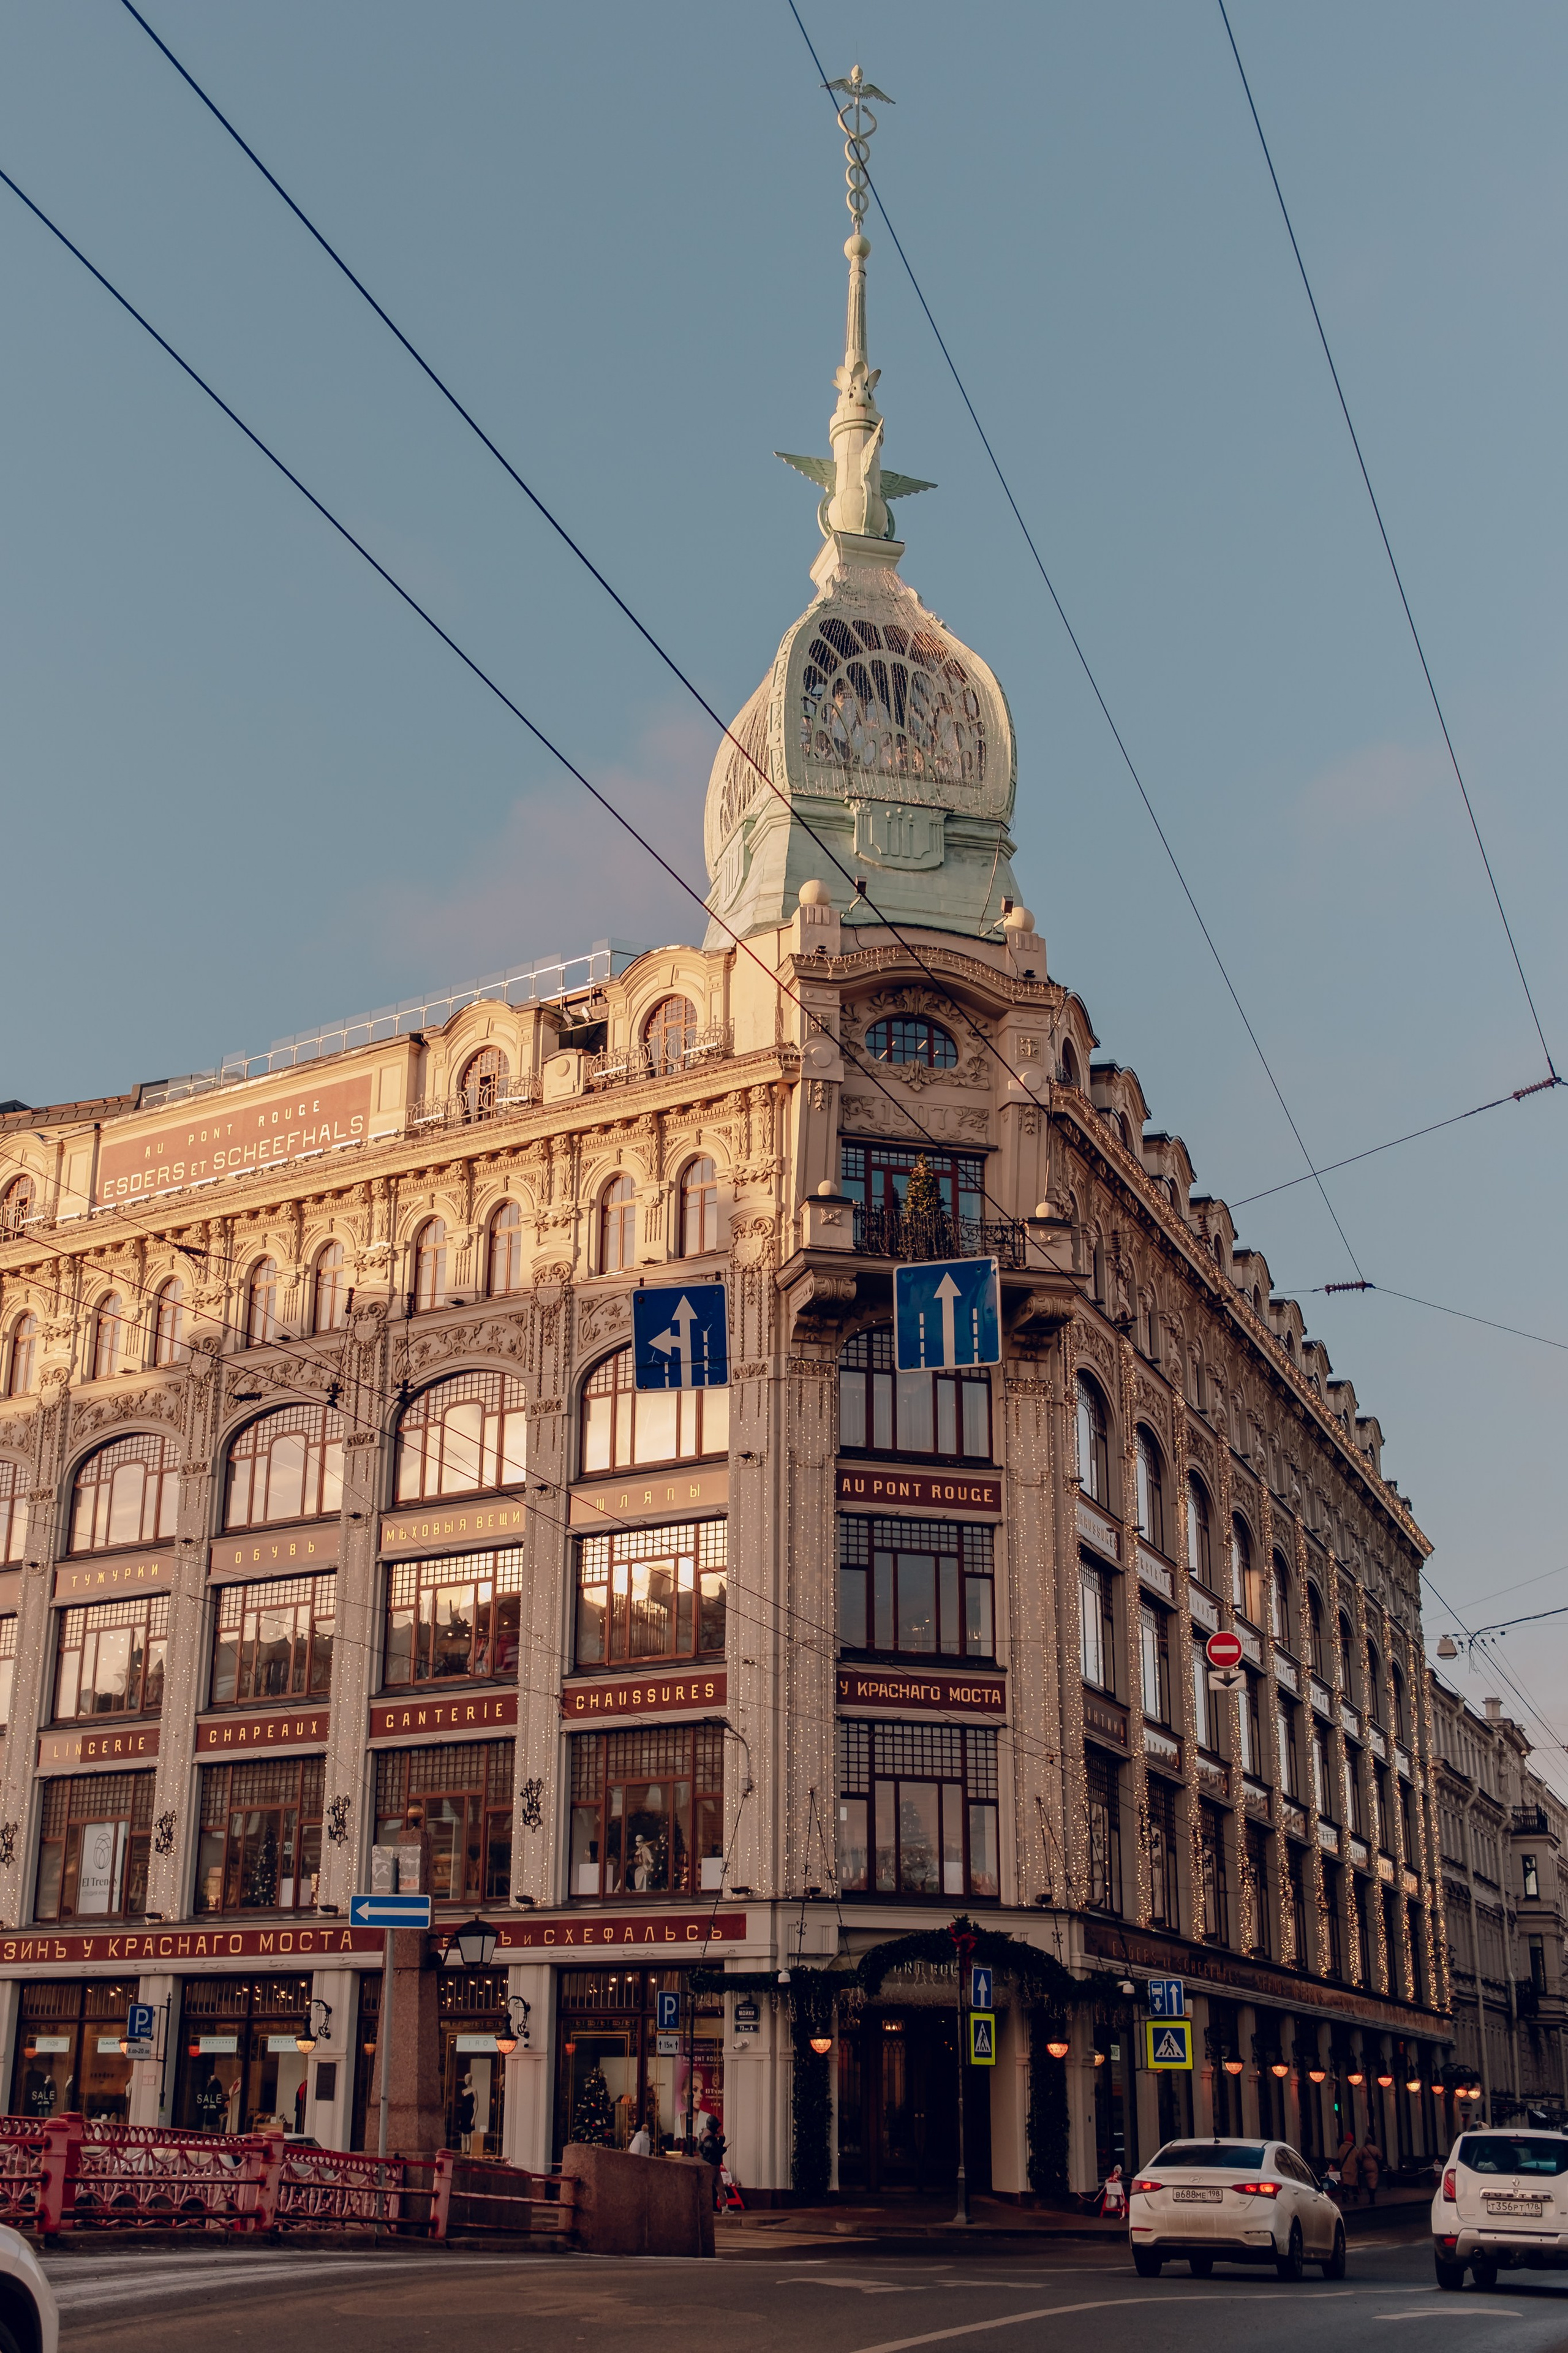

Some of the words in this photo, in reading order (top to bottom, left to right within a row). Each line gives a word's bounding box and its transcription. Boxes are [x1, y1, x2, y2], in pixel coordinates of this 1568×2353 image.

[144, 1141, 165, 1160] AU
[188, 1124, 233, 1147] PONT
[258, 1100, 321, 1128] ROUGE
[103, 1161, 186, 1199] ESDERS
[190, 1160, 206, 1177] ET
[213, 1114, 364, 1170] SCHEEFHALS
[596, 1483, 701, 1511] ШЛЯПЫ
[842, 1478, 864, 1493] AU
[873, 1480, 921, 1497] PONT
[932, 1484, 994, 1503] ROUGE
[477, 1509, 521, 1529] ВЕЩИ
[1079, 1511, 1118, 1551] HAUSSURES
[235, 1541, 316, 1563] ОБУВЬ
[72, 1563, 159, 1587] ТУЖУРКИ
[576, 1682, 715, 1710] CHAUSSURES
[840, 1680, 848, 1694] У
[858, 1681, 940, 1701] КРАСНАГО
[949, 1687, 1001, 1704] МОСТА
[209, 1720, 318, 1743] CHAPEAUX
[91, 1876, 118, 1888] Treny
[83, 1939, 93, 1958] У
[108, 1934, 243, 1957] КРАСНАГО
[259, 1930, 353, 1952] МОСТА
[894, 1961, 924, 1975] ONT
[31, 2090, 55, 2101] SALE
[196, 2093, 222, 2104] SALE
